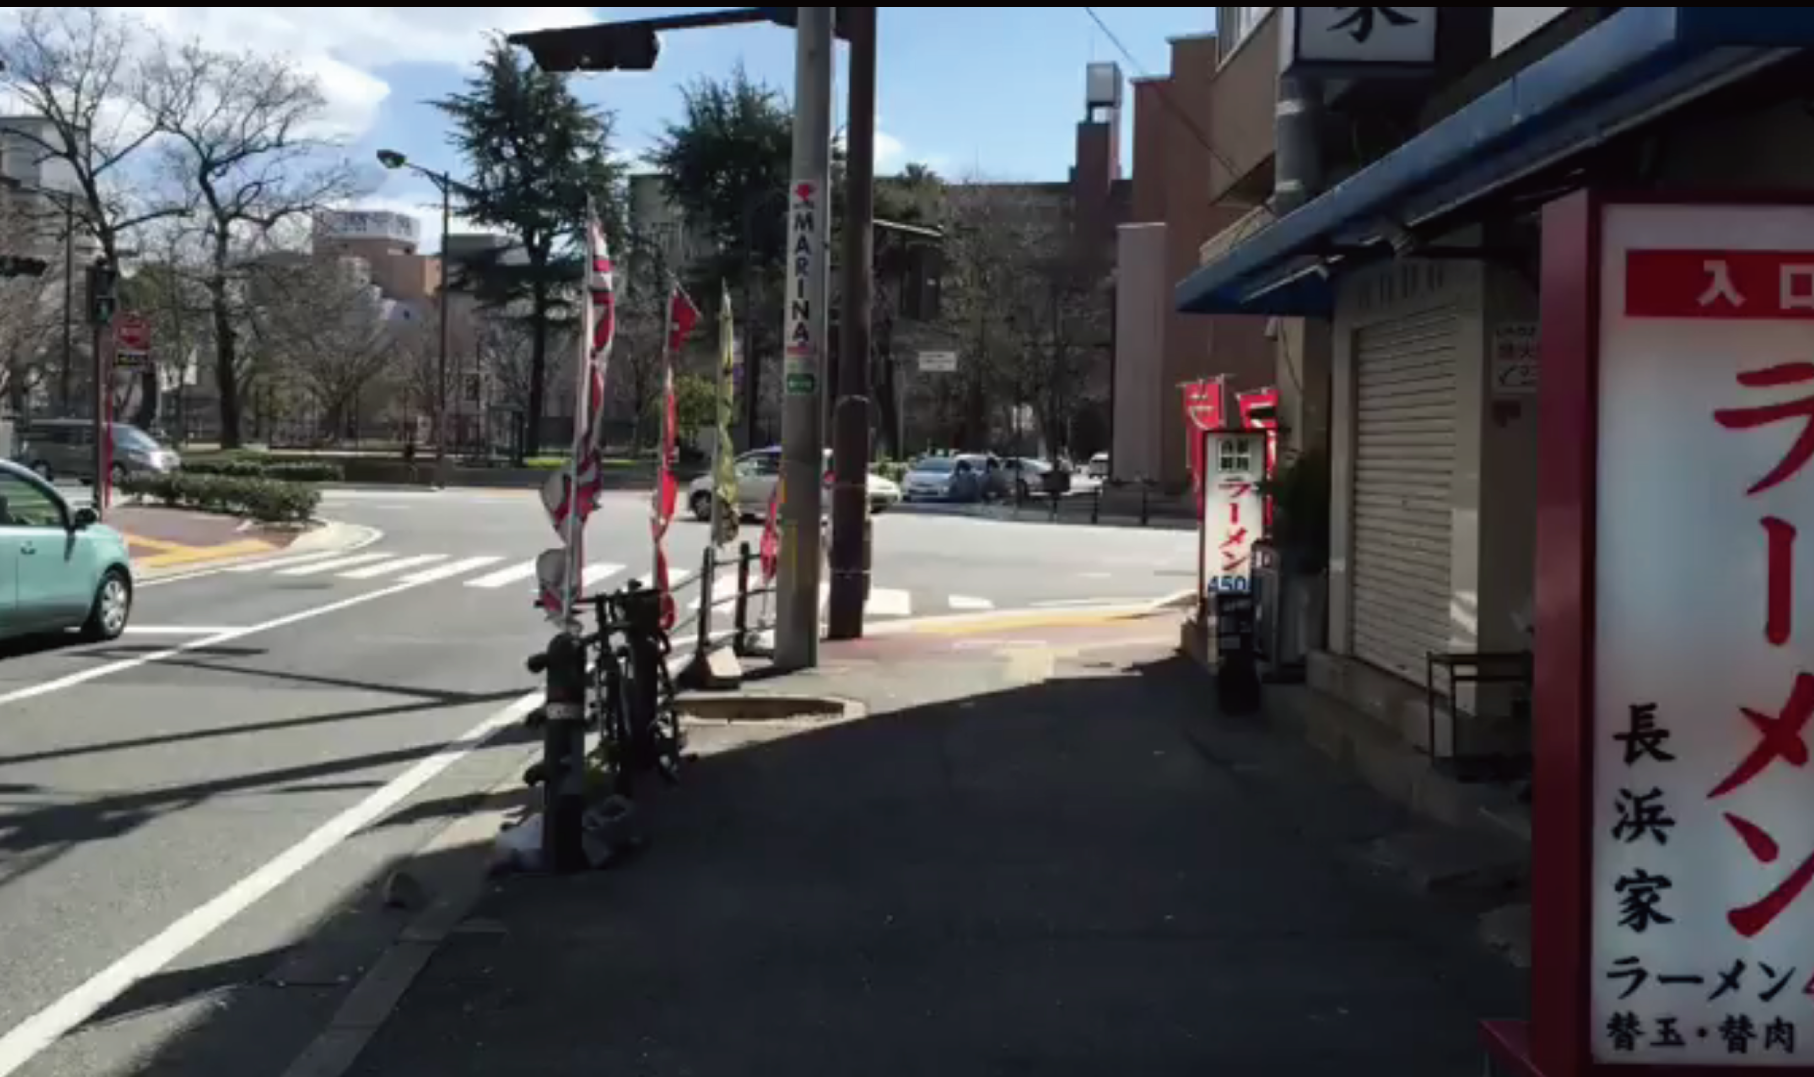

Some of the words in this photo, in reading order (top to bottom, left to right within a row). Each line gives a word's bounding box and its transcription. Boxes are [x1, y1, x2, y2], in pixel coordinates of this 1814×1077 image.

[792, 211, 815, 343] MARINA
[1696, 259, 1814, 309] 入口
[1218, 476, 1250, 572] ラーメン
[1707, 361, 1814, 939] ラーメン
[1612, 702, 1677, 933] 長浜家
[1606, 955, 1797, 1002] ラーメン
[1606, 1011, 1797, 1055] 替玉・替肉
